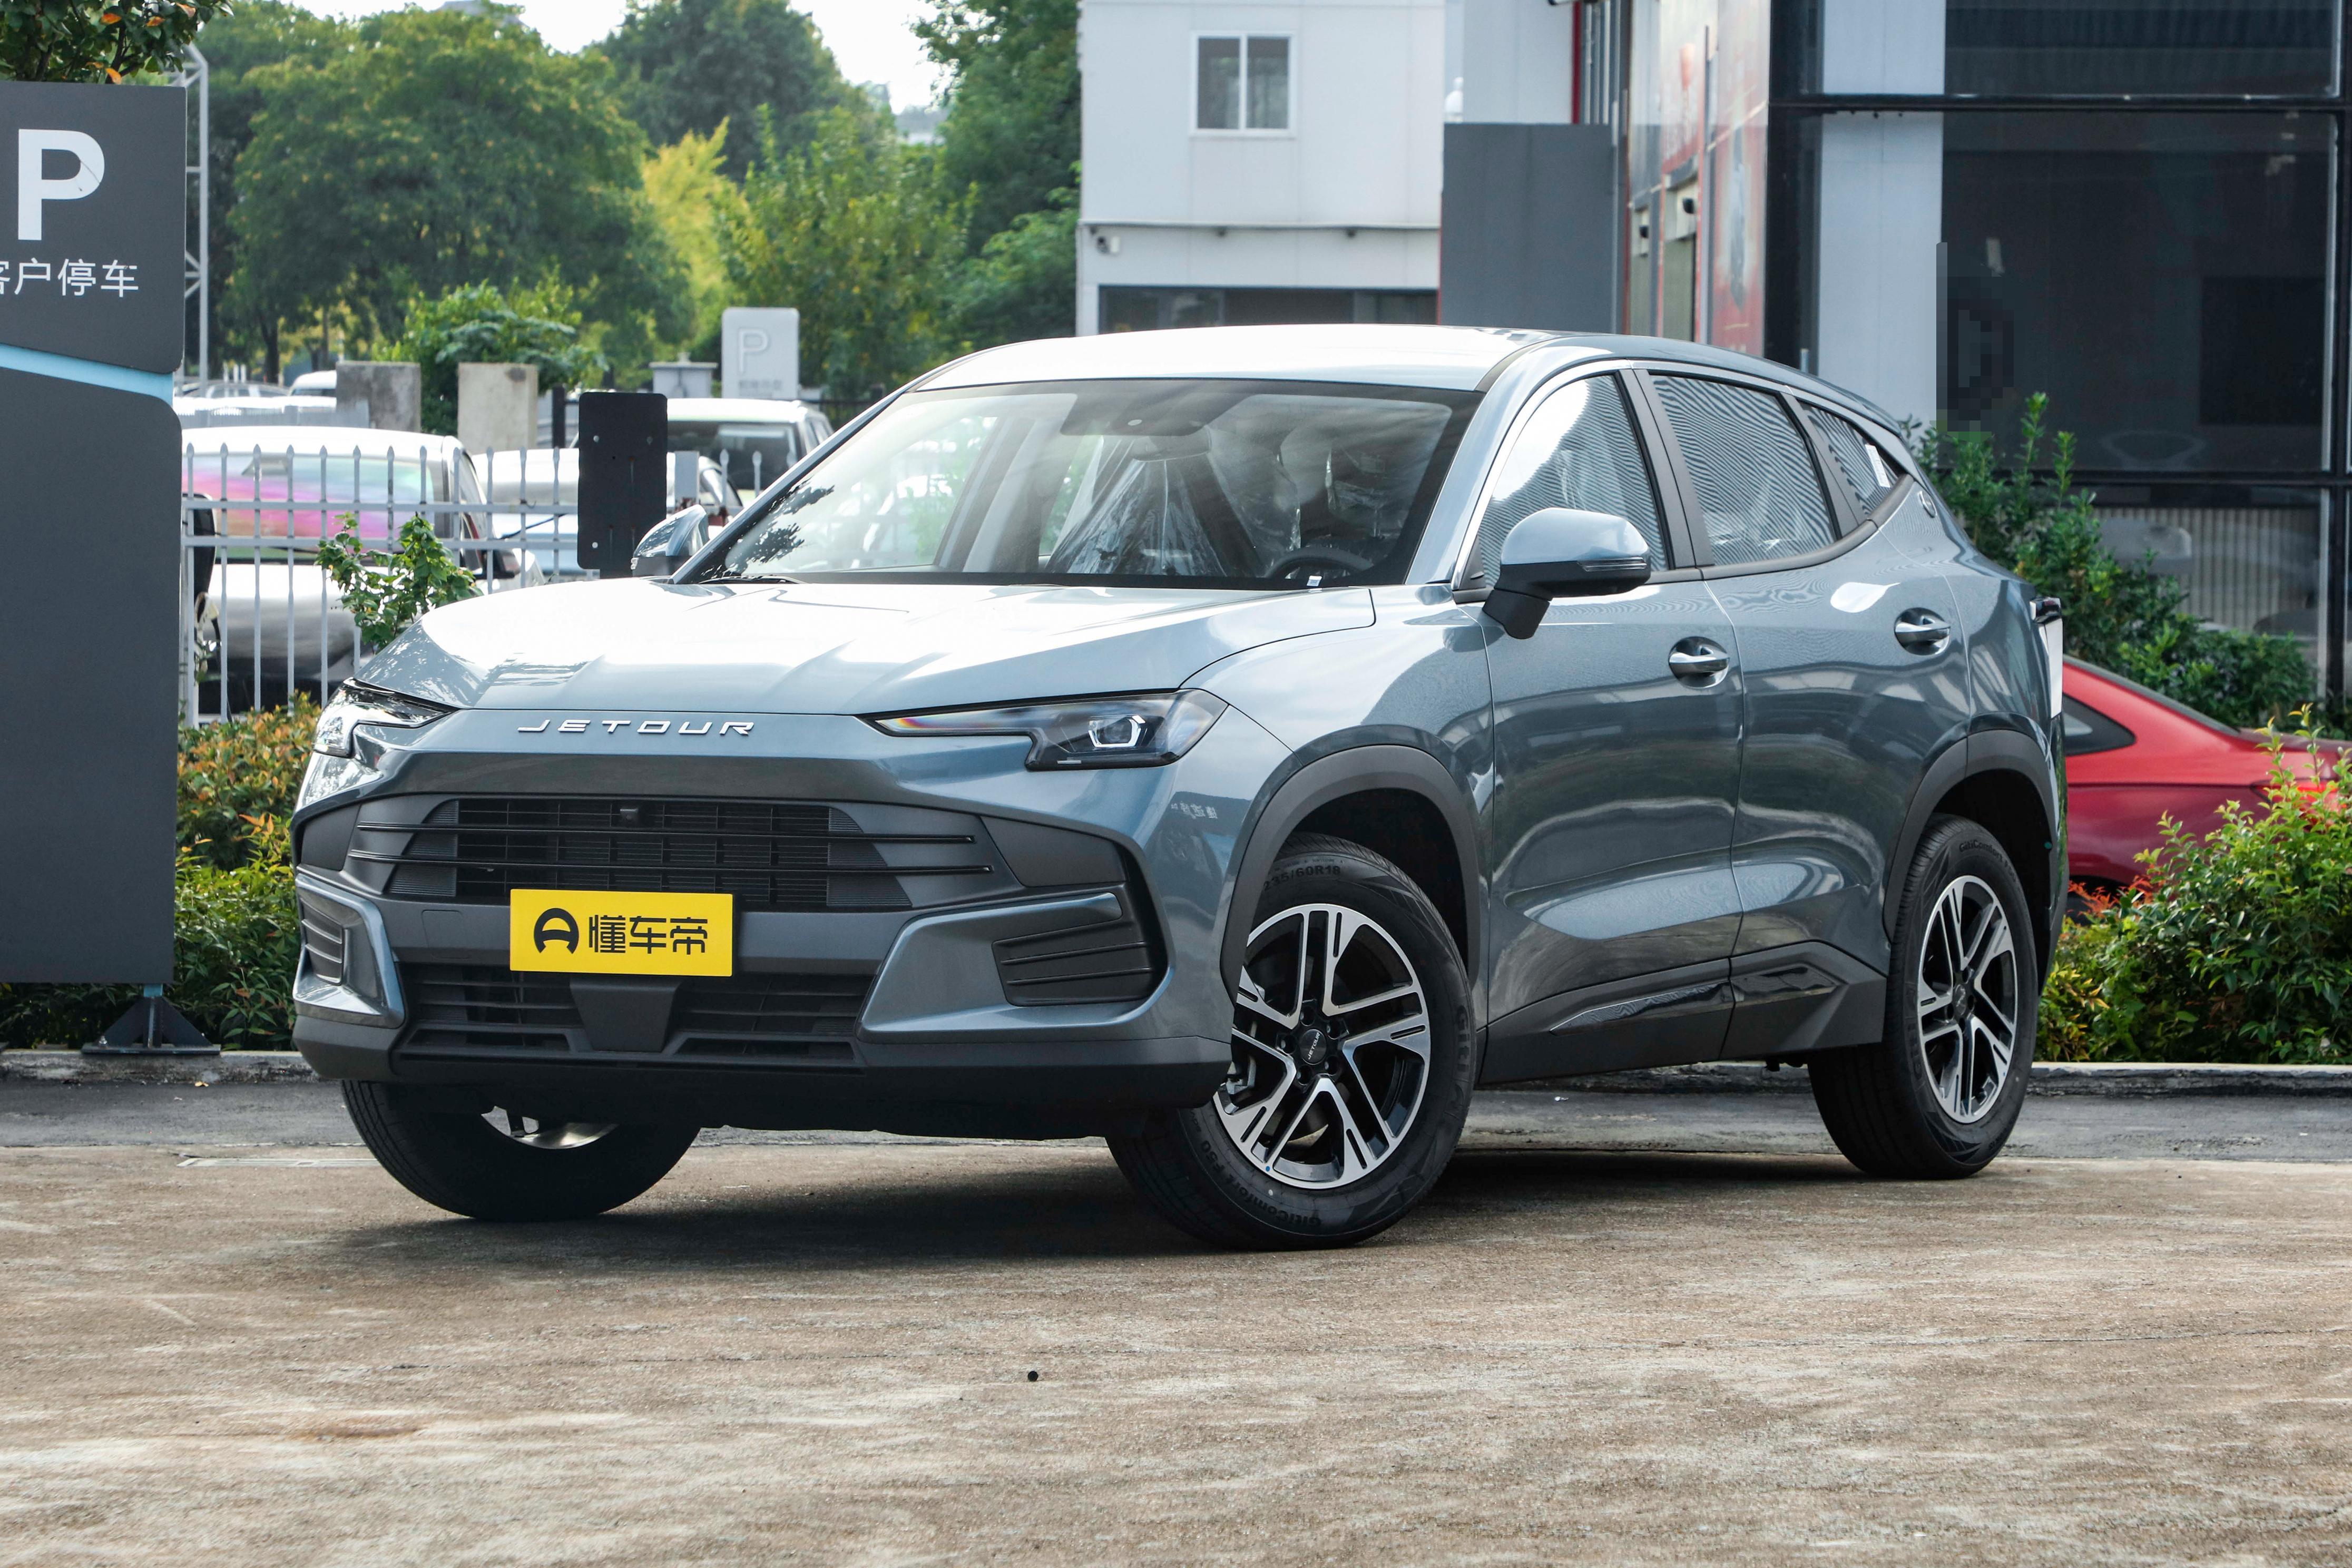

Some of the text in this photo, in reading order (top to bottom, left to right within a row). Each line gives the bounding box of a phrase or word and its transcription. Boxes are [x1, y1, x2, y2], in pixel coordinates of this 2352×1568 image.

[18, 129, 105, 241] P
[0, 257, 139, 298] 户停车
[738, 327, 769, 374] P
[517, 719, 754, 736] JETOUR
[588, 914, 708, 955] 懂车帝
[1307, 1032, 1321, 1060] JETOUR
